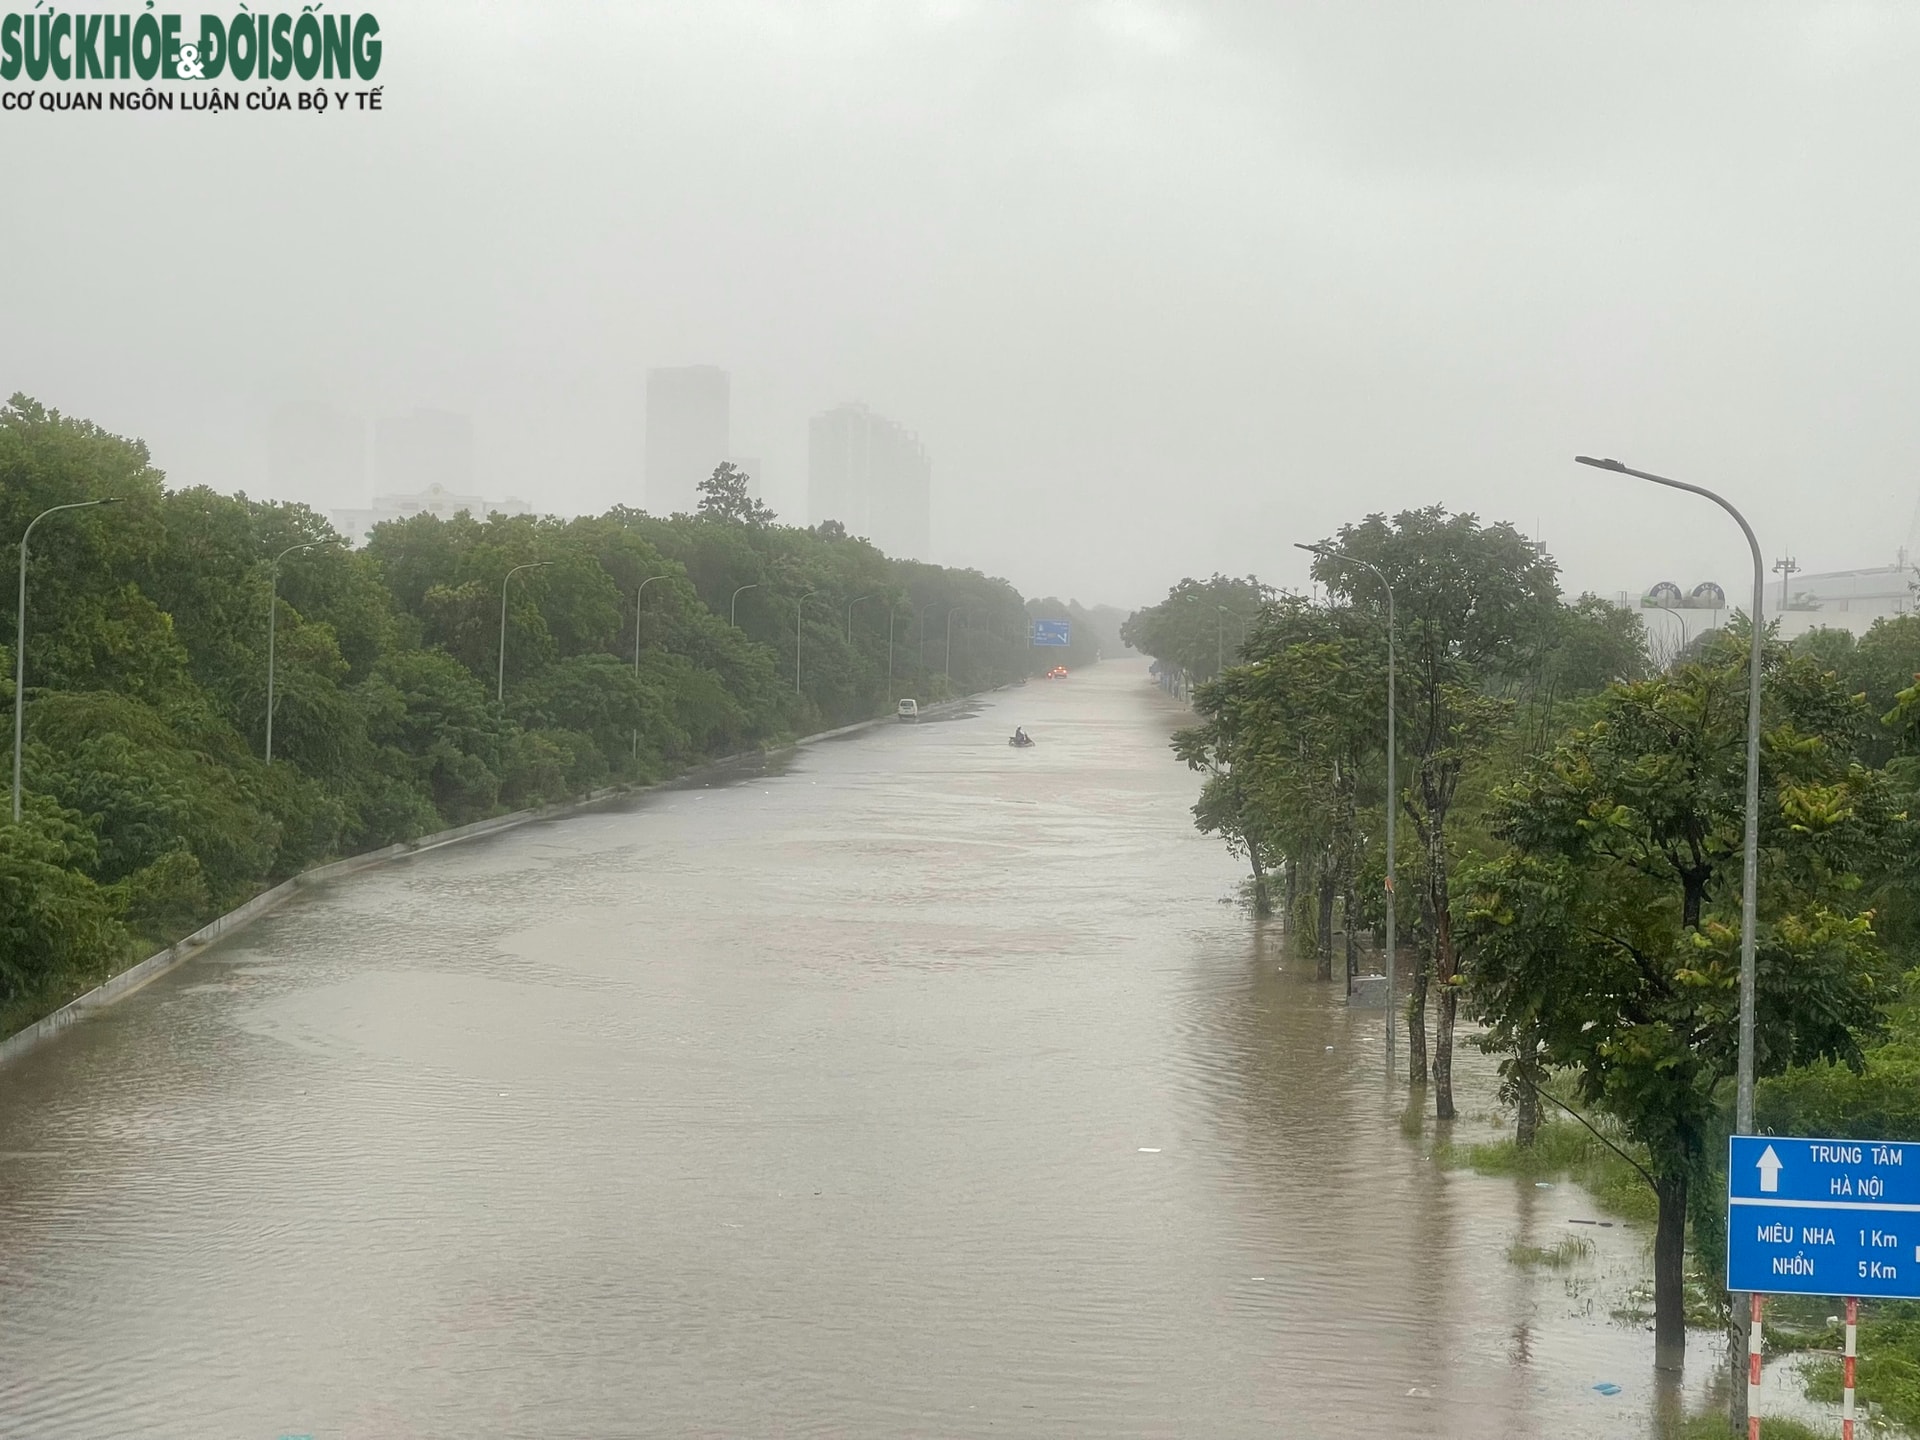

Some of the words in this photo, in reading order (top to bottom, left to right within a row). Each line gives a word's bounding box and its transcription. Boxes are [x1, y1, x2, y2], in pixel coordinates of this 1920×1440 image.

[1809, 1145, 1863, 1165] TRUNG
[1870, 1144, 1903, 1167] TÂM
[1829, 1173, 1853, 1196] HÀ
[1857, 1175, 1884, 1200] NỘI
[1756, 1222, 1794, 1243] MIÊU
[1802, 1227, 1836, 1245] NHA
[1858, 1229, 1866, 1247] 1
[1871, 1229, 1898, 1248] Km
[1772, 1250, 1815, 1276] NHỔN
[1858, 1260, 1868, 1278] 5
[1870, 1260, 1897, 1280] Km
